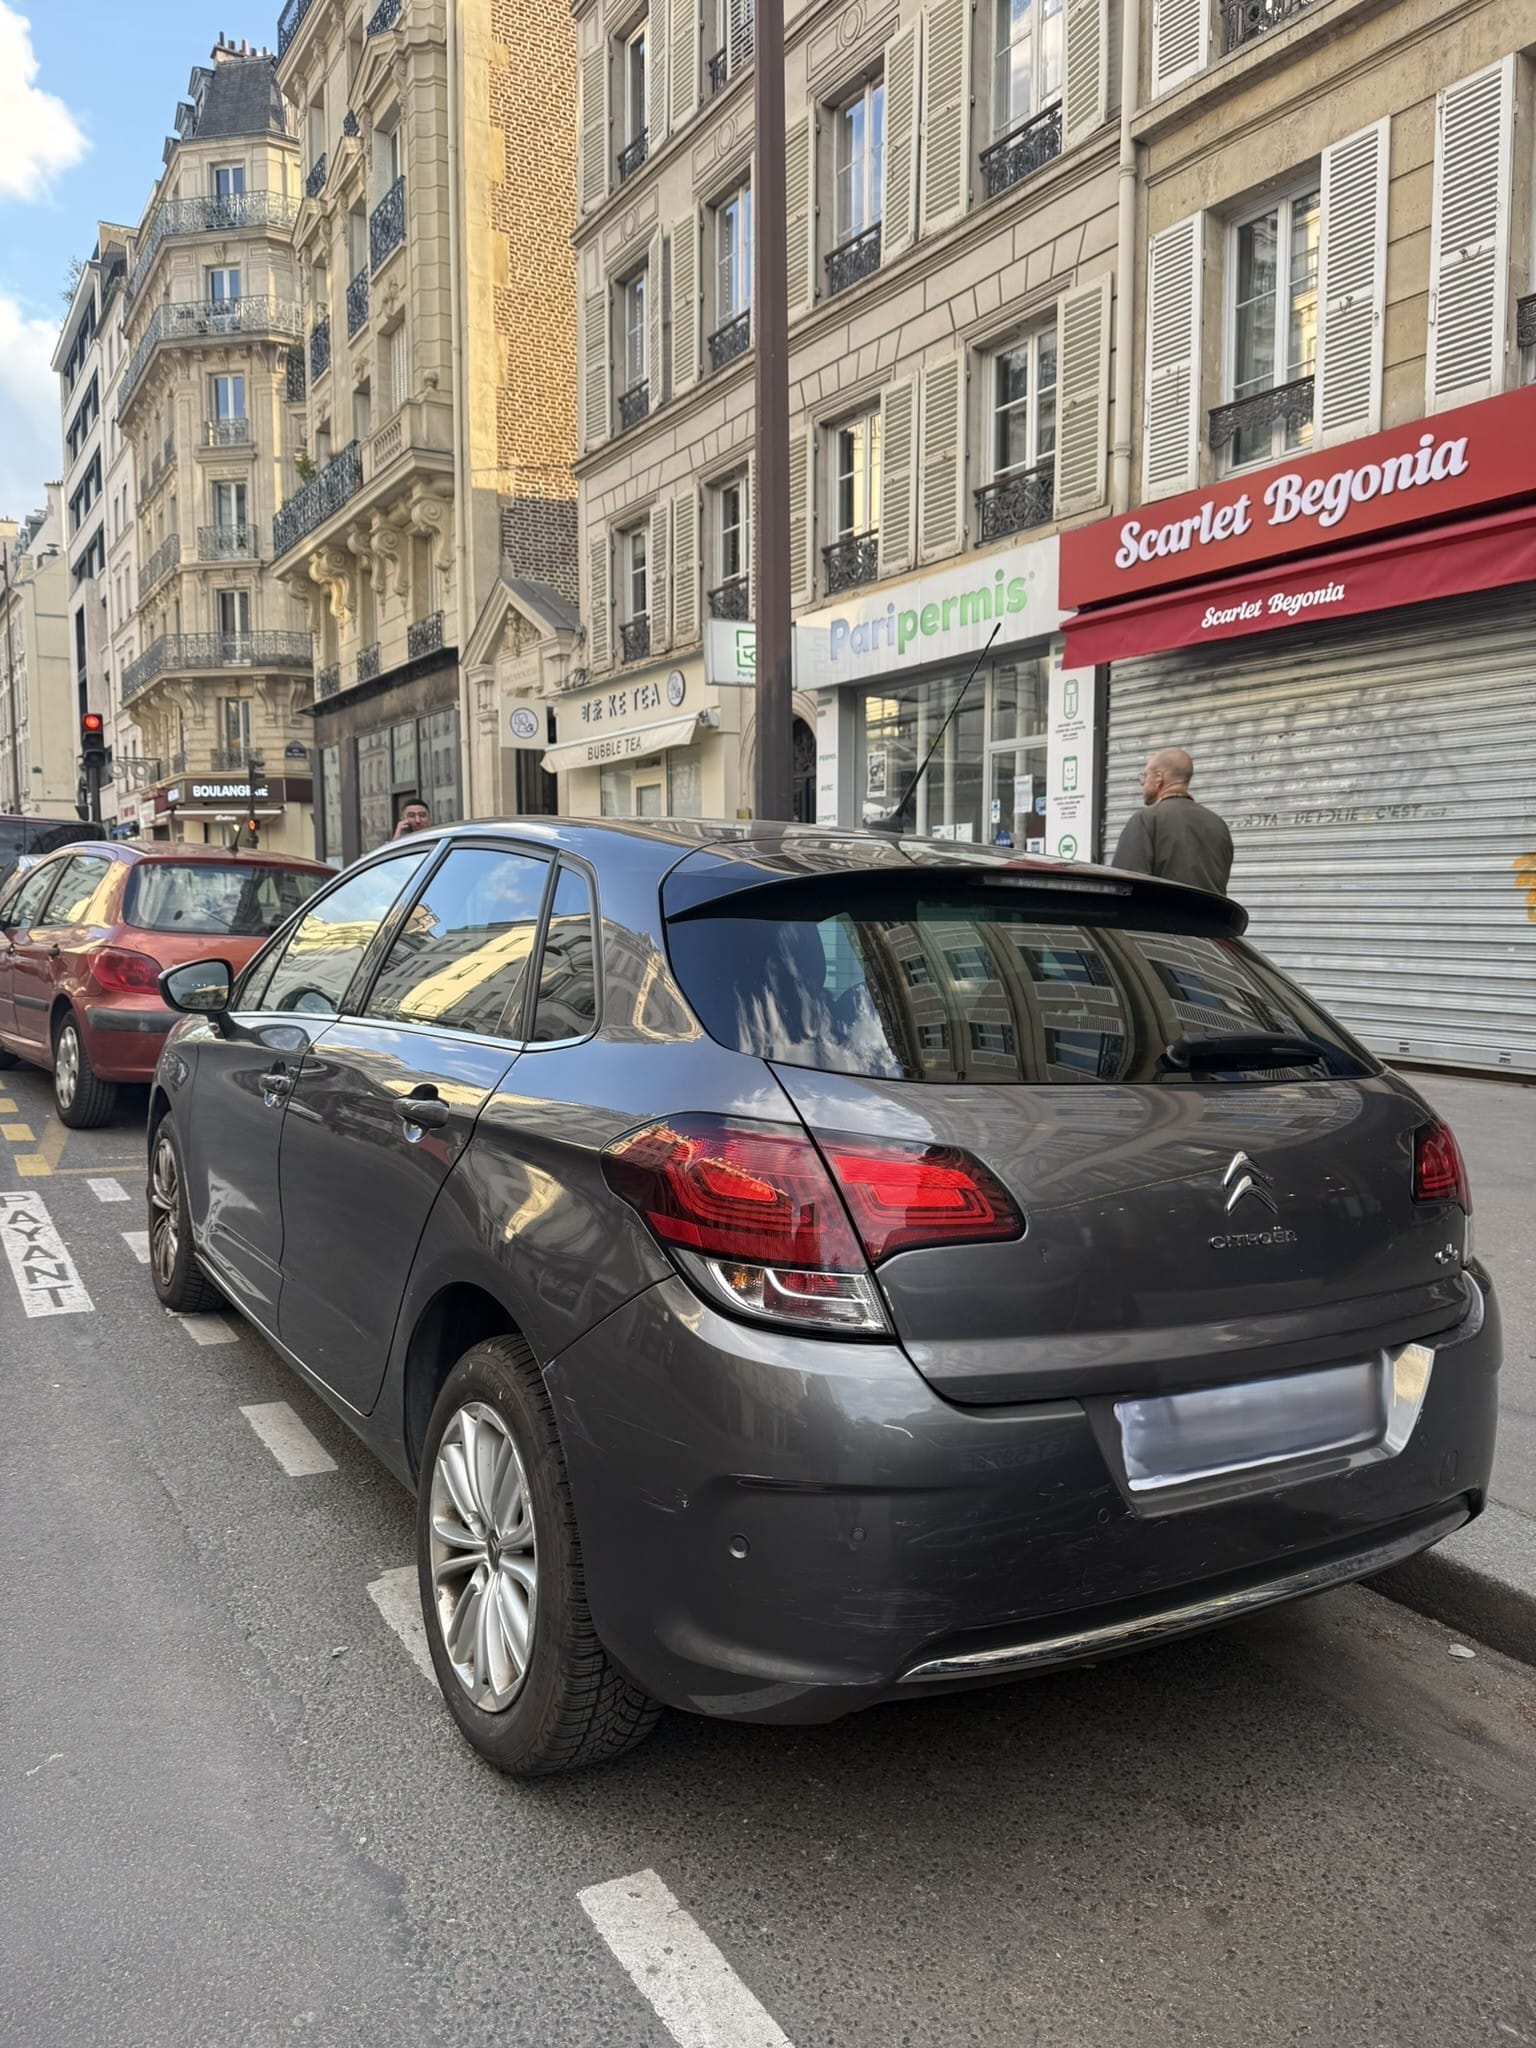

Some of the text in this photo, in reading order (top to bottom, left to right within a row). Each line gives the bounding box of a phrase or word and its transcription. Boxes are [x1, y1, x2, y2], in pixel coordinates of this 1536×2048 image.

[1114, 433, 1470, 569] Scarlet Begonia
[829, 568, 1028, 661] Paripermis
[1201, 581, 1345, 629] Scarlet Begonia
[608, 691, 627, 718] KE
[630, 682, 661, 712] TEA
[587, 736, 642, 761] BUBBLE TEA
[0, 1195, 75, 1308] PAYANT
